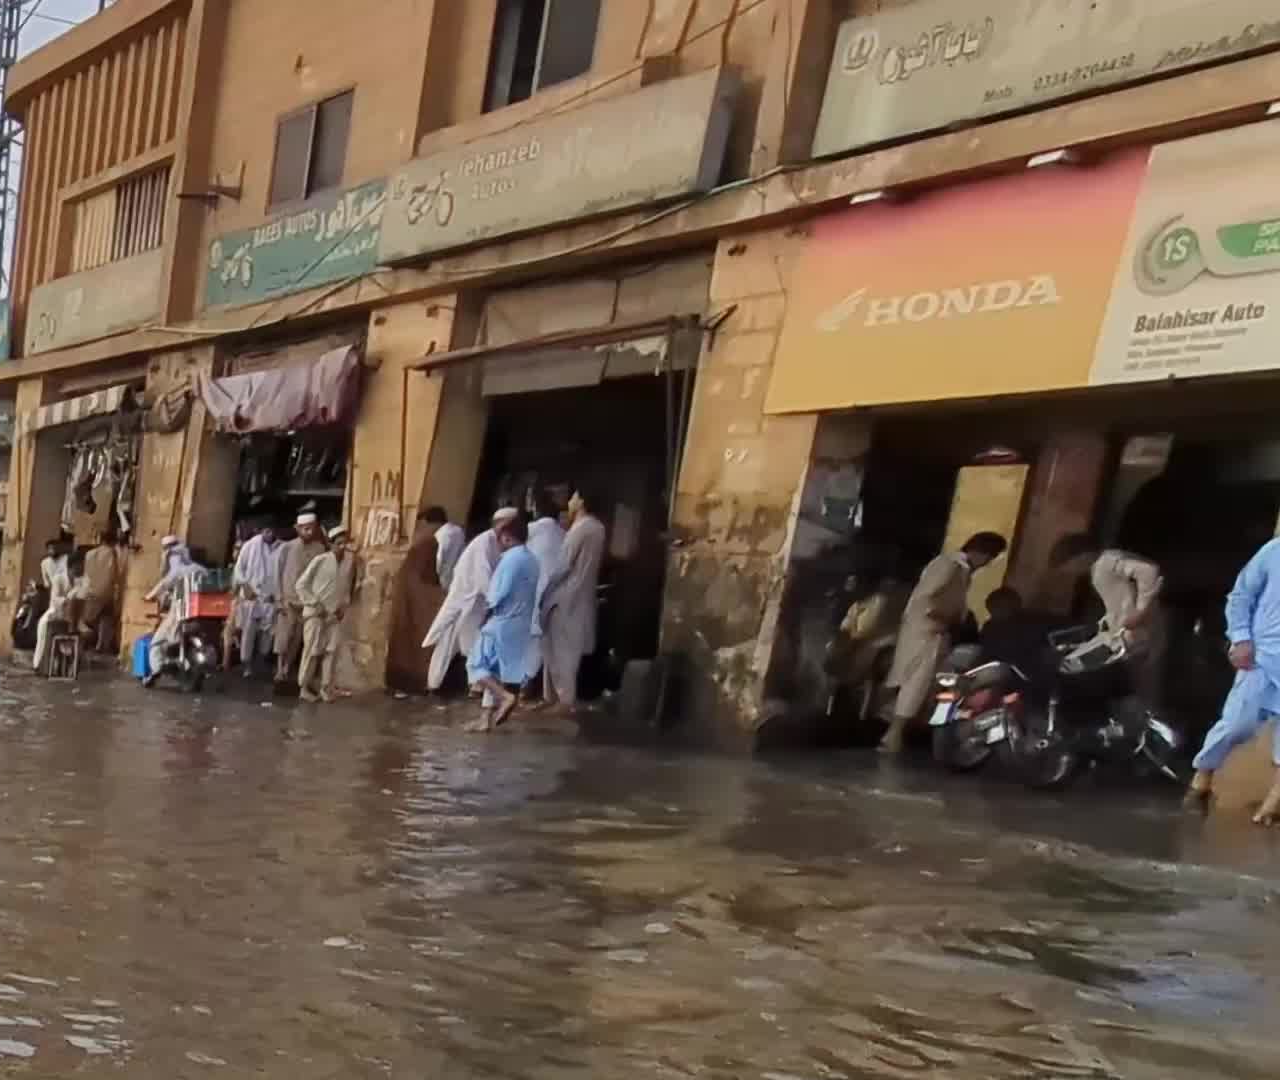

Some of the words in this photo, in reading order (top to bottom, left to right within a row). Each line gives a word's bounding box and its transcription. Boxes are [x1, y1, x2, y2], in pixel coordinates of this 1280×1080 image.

[863, 273, 1063, 327] HONDA
[1133, 307, 1219, 334] Balahisar
[1221, 302, 1266, 323] Auto
